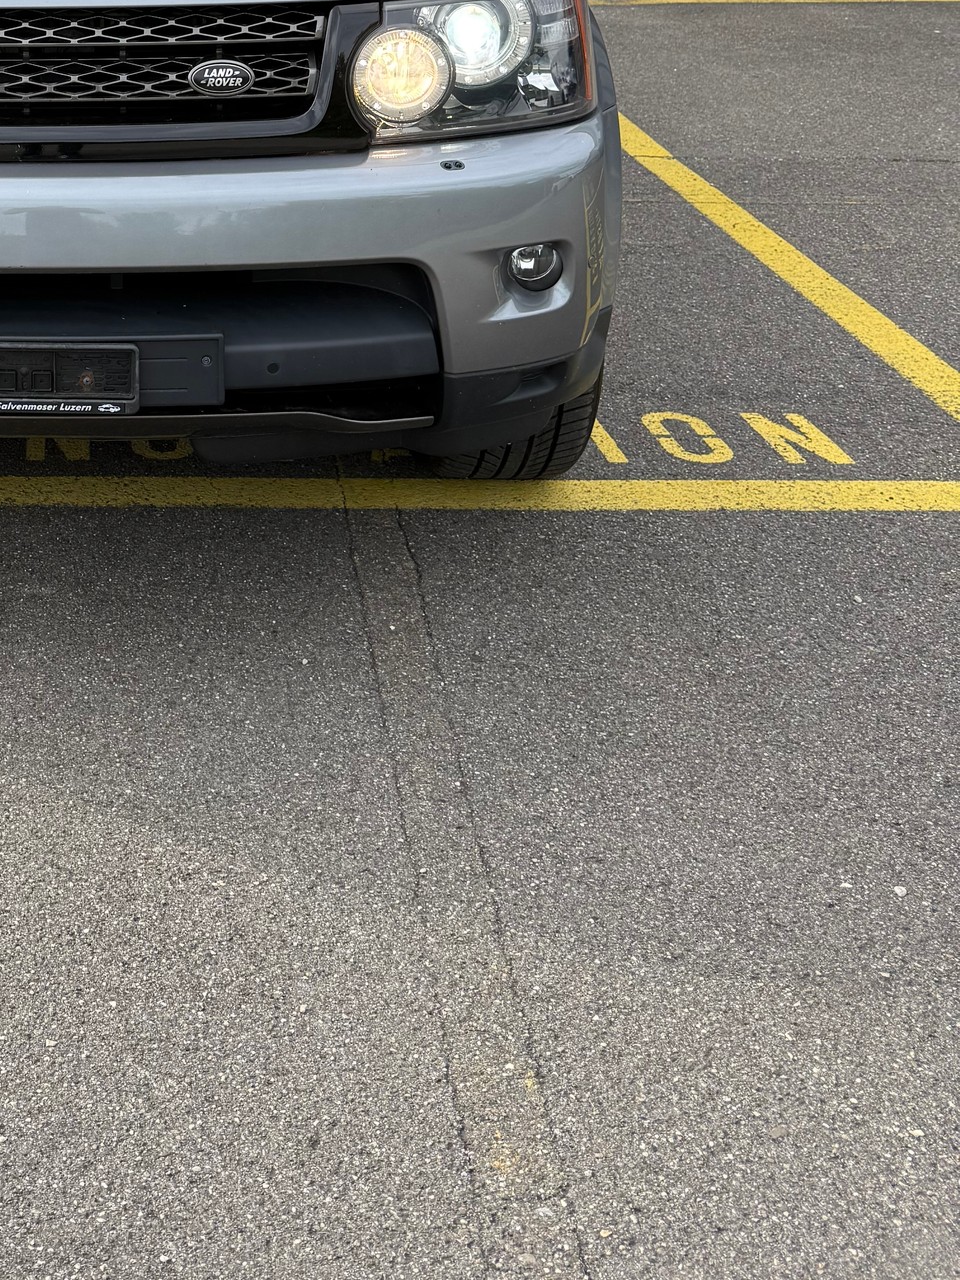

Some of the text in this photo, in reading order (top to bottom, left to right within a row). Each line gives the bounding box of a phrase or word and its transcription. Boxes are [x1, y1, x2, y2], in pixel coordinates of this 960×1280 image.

[203, 68, 234, 78] LAND
[206, 77, 243, 87] ROVER
[59, 402, 92, 412] Luzern
